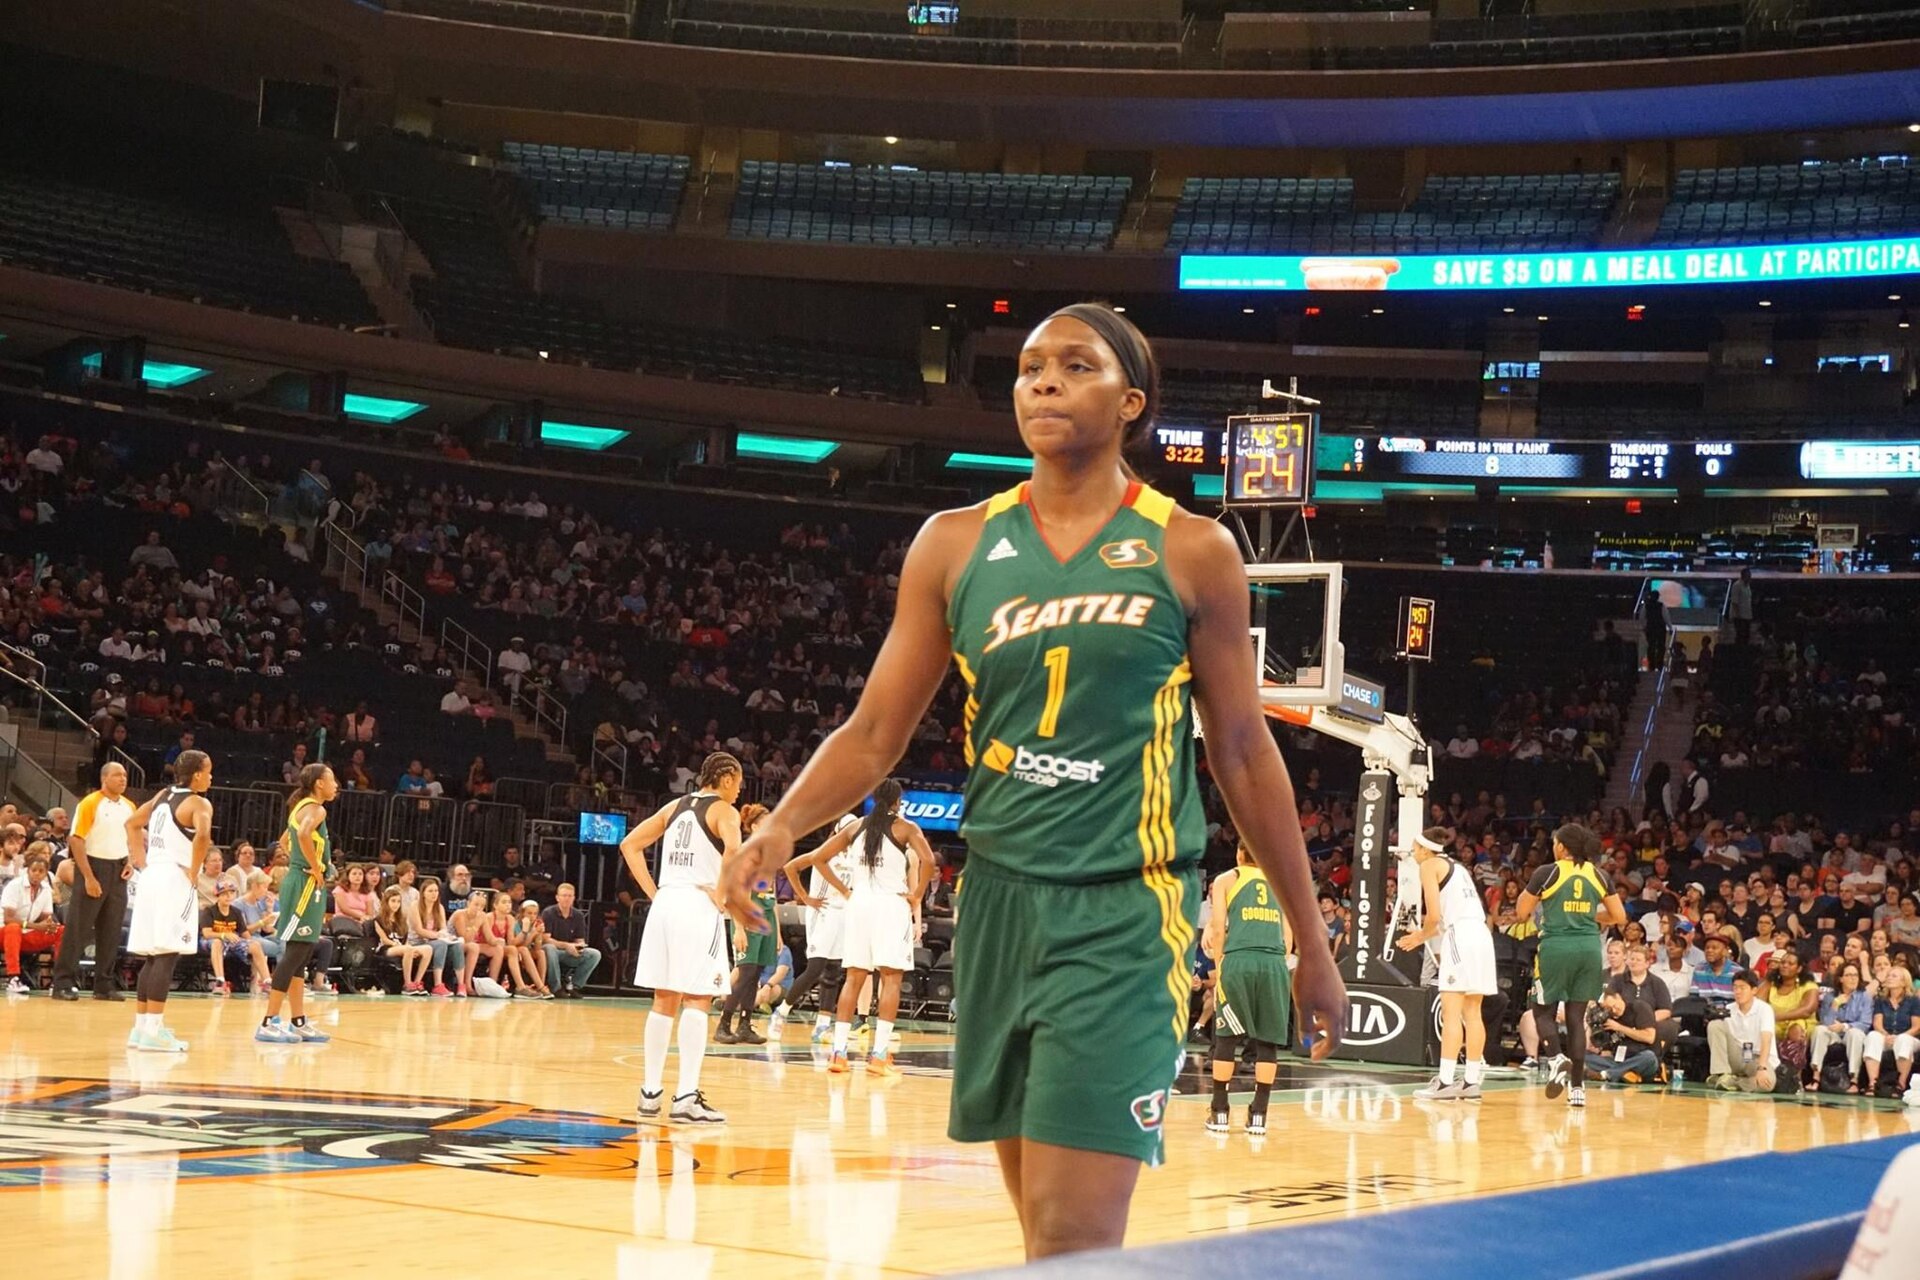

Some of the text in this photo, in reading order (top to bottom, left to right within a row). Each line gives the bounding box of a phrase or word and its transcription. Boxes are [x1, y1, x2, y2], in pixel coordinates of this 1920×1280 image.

[1433, 243, 1920, 285] SAVE $5 ON A MEAL DEAL AT PARTICIPA
[1157, 429, 1204, 446] TIME
[1354, 438, 1365, 451] 0
[1436, 440, 1476, 453] POINTS
[1478, 441, 1491, 453] IN
[1492, 442, 1514, 454] THE
[1515, 442, 1550, 454] PAINT
[1165, 446, 1204, 463] 3:22
[1354, 451, 1363, 463] 2
[1610, 443, 1669, 455] TIMEOUTS
[1695, 443, 1732, 456] FOULS
[1485, 455, 1500, 474] 8
[1610, 455, 1639, 467] FULL
[1654, 456, 1664, 467] 2
[1706, 458, 1719, 475] 0
[1243, 452, 1295, 495] 24
[983, 595, 1155, 654] SEATTLE
[1409, 626, 1423, 648] 24
[1037, 645, 1070, 738] 1
[1343, 683, 1372, 704] CHASE
[1014, 745, 1105, 783] boost
[1013, 770, 1059, 788] mobile
[674, 820, 693, 849] 30
[1256, 883, 1268, 905] 3
[1573, 879, 1584, 899] 9
